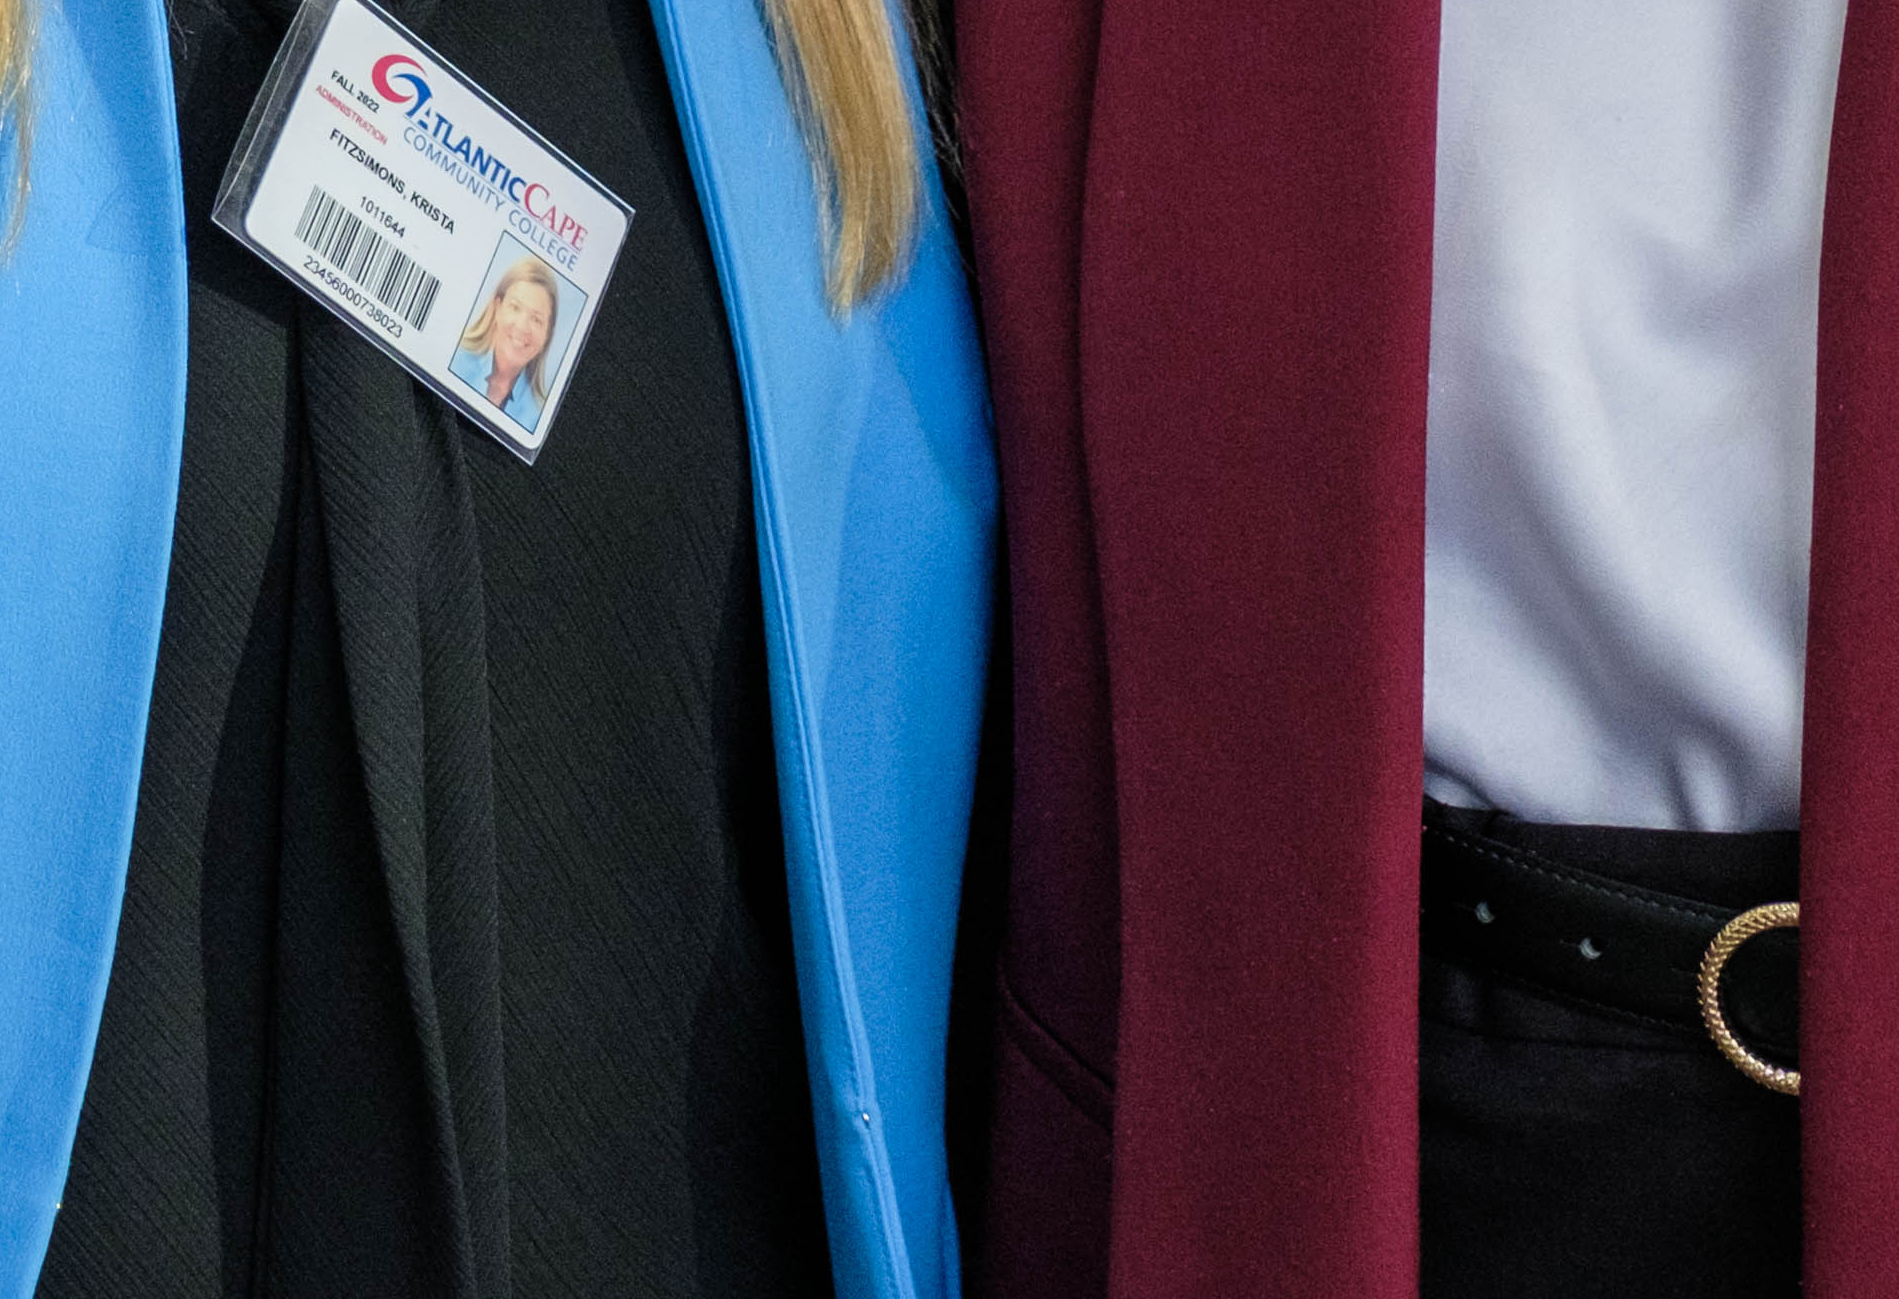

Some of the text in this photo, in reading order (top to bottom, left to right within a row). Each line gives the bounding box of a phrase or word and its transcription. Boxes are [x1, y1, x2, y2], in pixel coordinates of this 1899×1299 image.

[316, 84, 388, 146] ADMINISTRATION
[331, 70, 380, 114] FALL 2022
[330, 128, 455, 234] FITZSIMONS, KRISTA
[403, 126, 579, 271] COMMUNITY COLLEGE
[360, 196, 405, 238] 1011644
